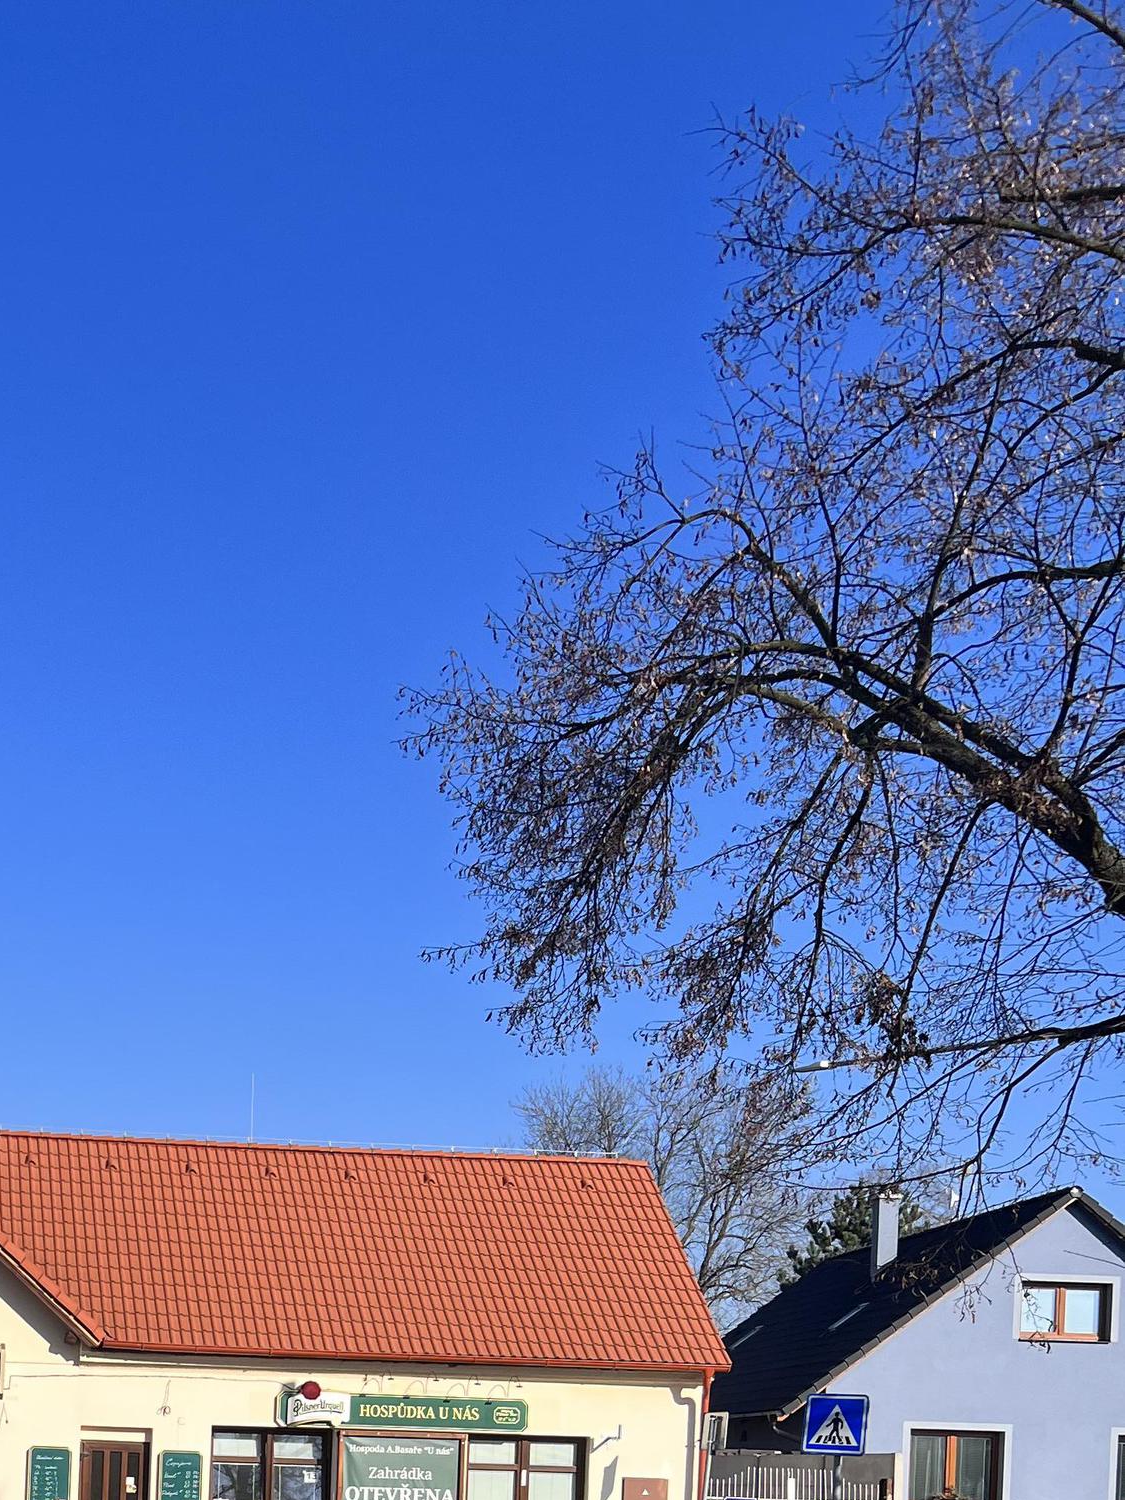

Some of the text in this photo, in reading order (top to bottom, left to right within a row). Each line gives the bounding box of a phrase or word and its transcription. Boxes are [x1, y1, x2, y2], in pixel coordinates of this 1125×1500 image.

[293, 1399, 344, 1417] Pilsner Urquell
[360, 1403, 435, 1420] HOSPŮDKA
[439, 1407, 449, 1420] U
[452, 1404, 480, 1421] NÁS
[349, 1444, 385, 1454] Hospoda
[368, 1466, 432, 1480] Zahrádka
